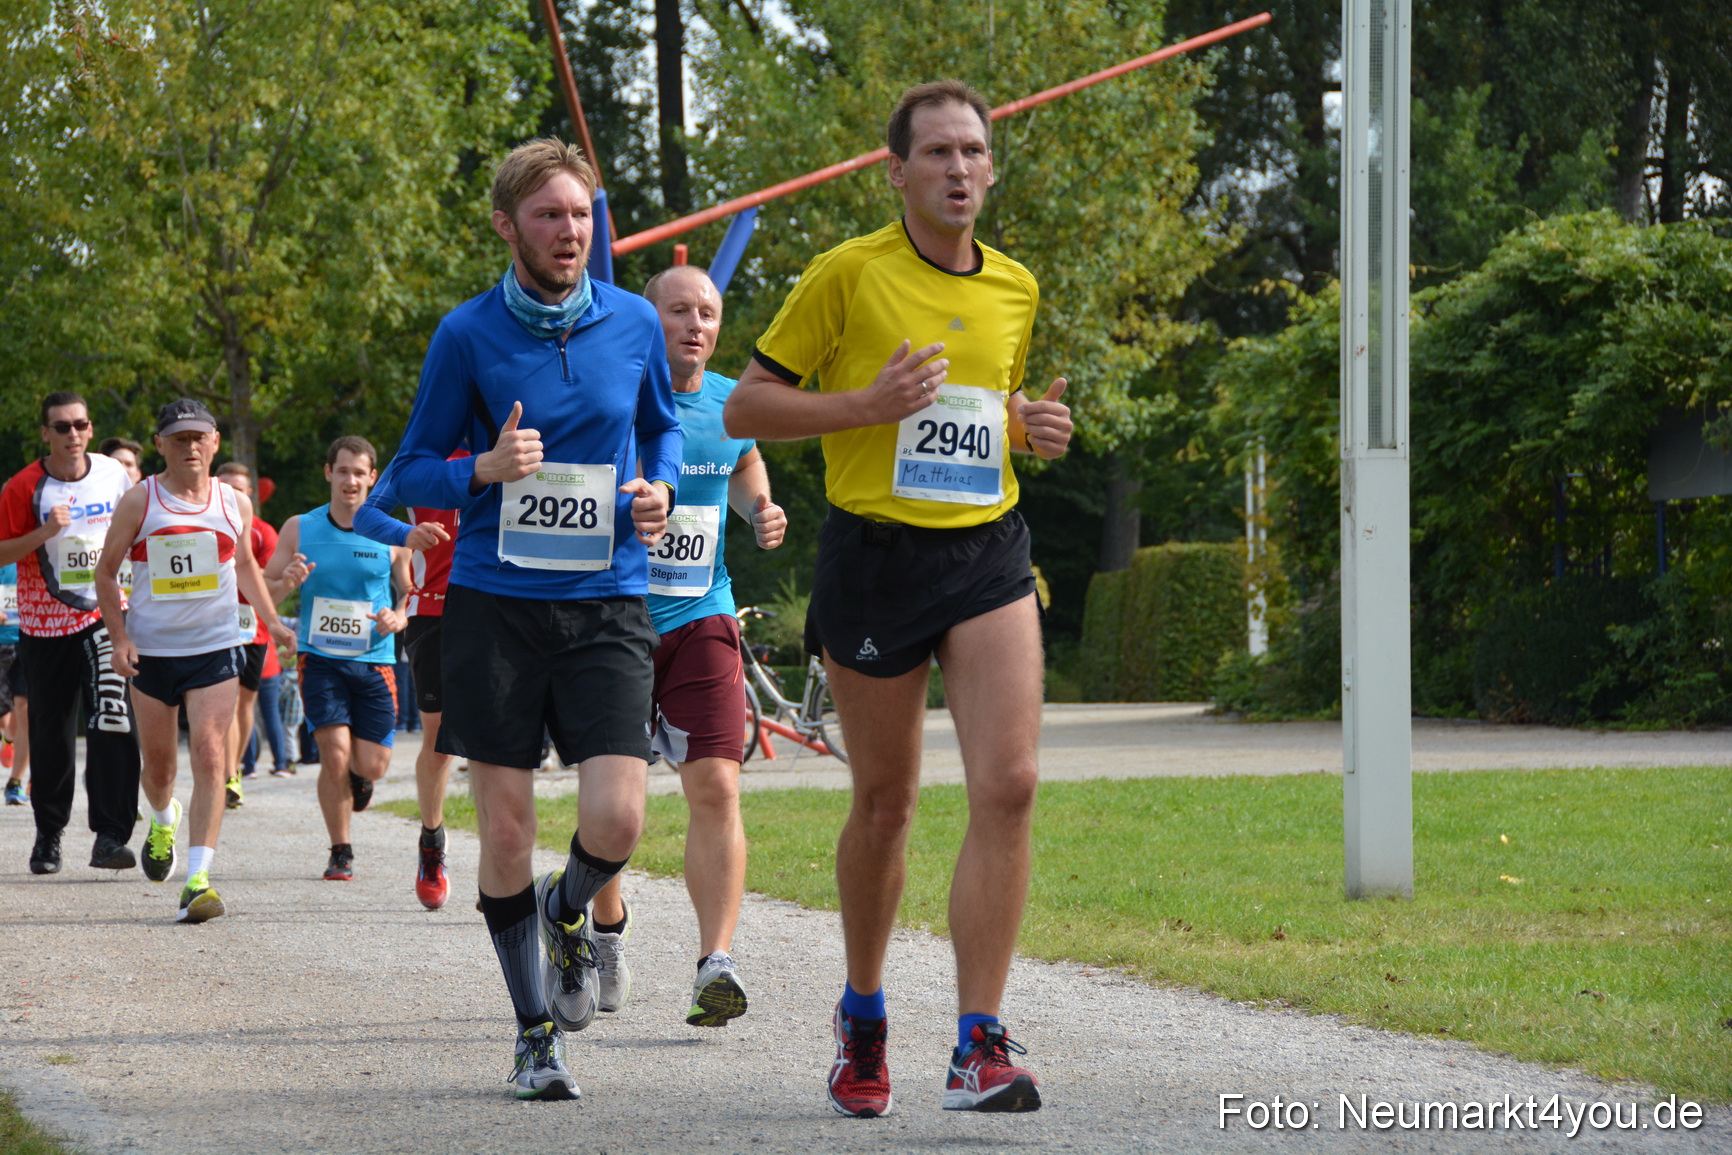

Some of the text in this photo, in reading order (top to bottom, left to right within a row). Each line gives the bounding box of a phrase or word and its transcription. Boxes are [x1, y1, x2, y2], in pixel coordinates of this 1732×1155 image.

[948, 395, 983, 408] BOCK
[915, 419, 990, 460] 2940
[681, 462, 733, 476] hasit.de
[902, 463, 973, 486] Matthias
[547, 473, 585, 483] BOCK
[518, 494, 598, 529] 2928
[353, 551, 379, 559] THULE
[170, 554, 193, 574] 61
[650, 567, 688, 581] Stephan
[169, 580, 201, 590] Siegfried
[319, 616, 362, 635] 2655
[325, 638, 352, 647] Matthias
